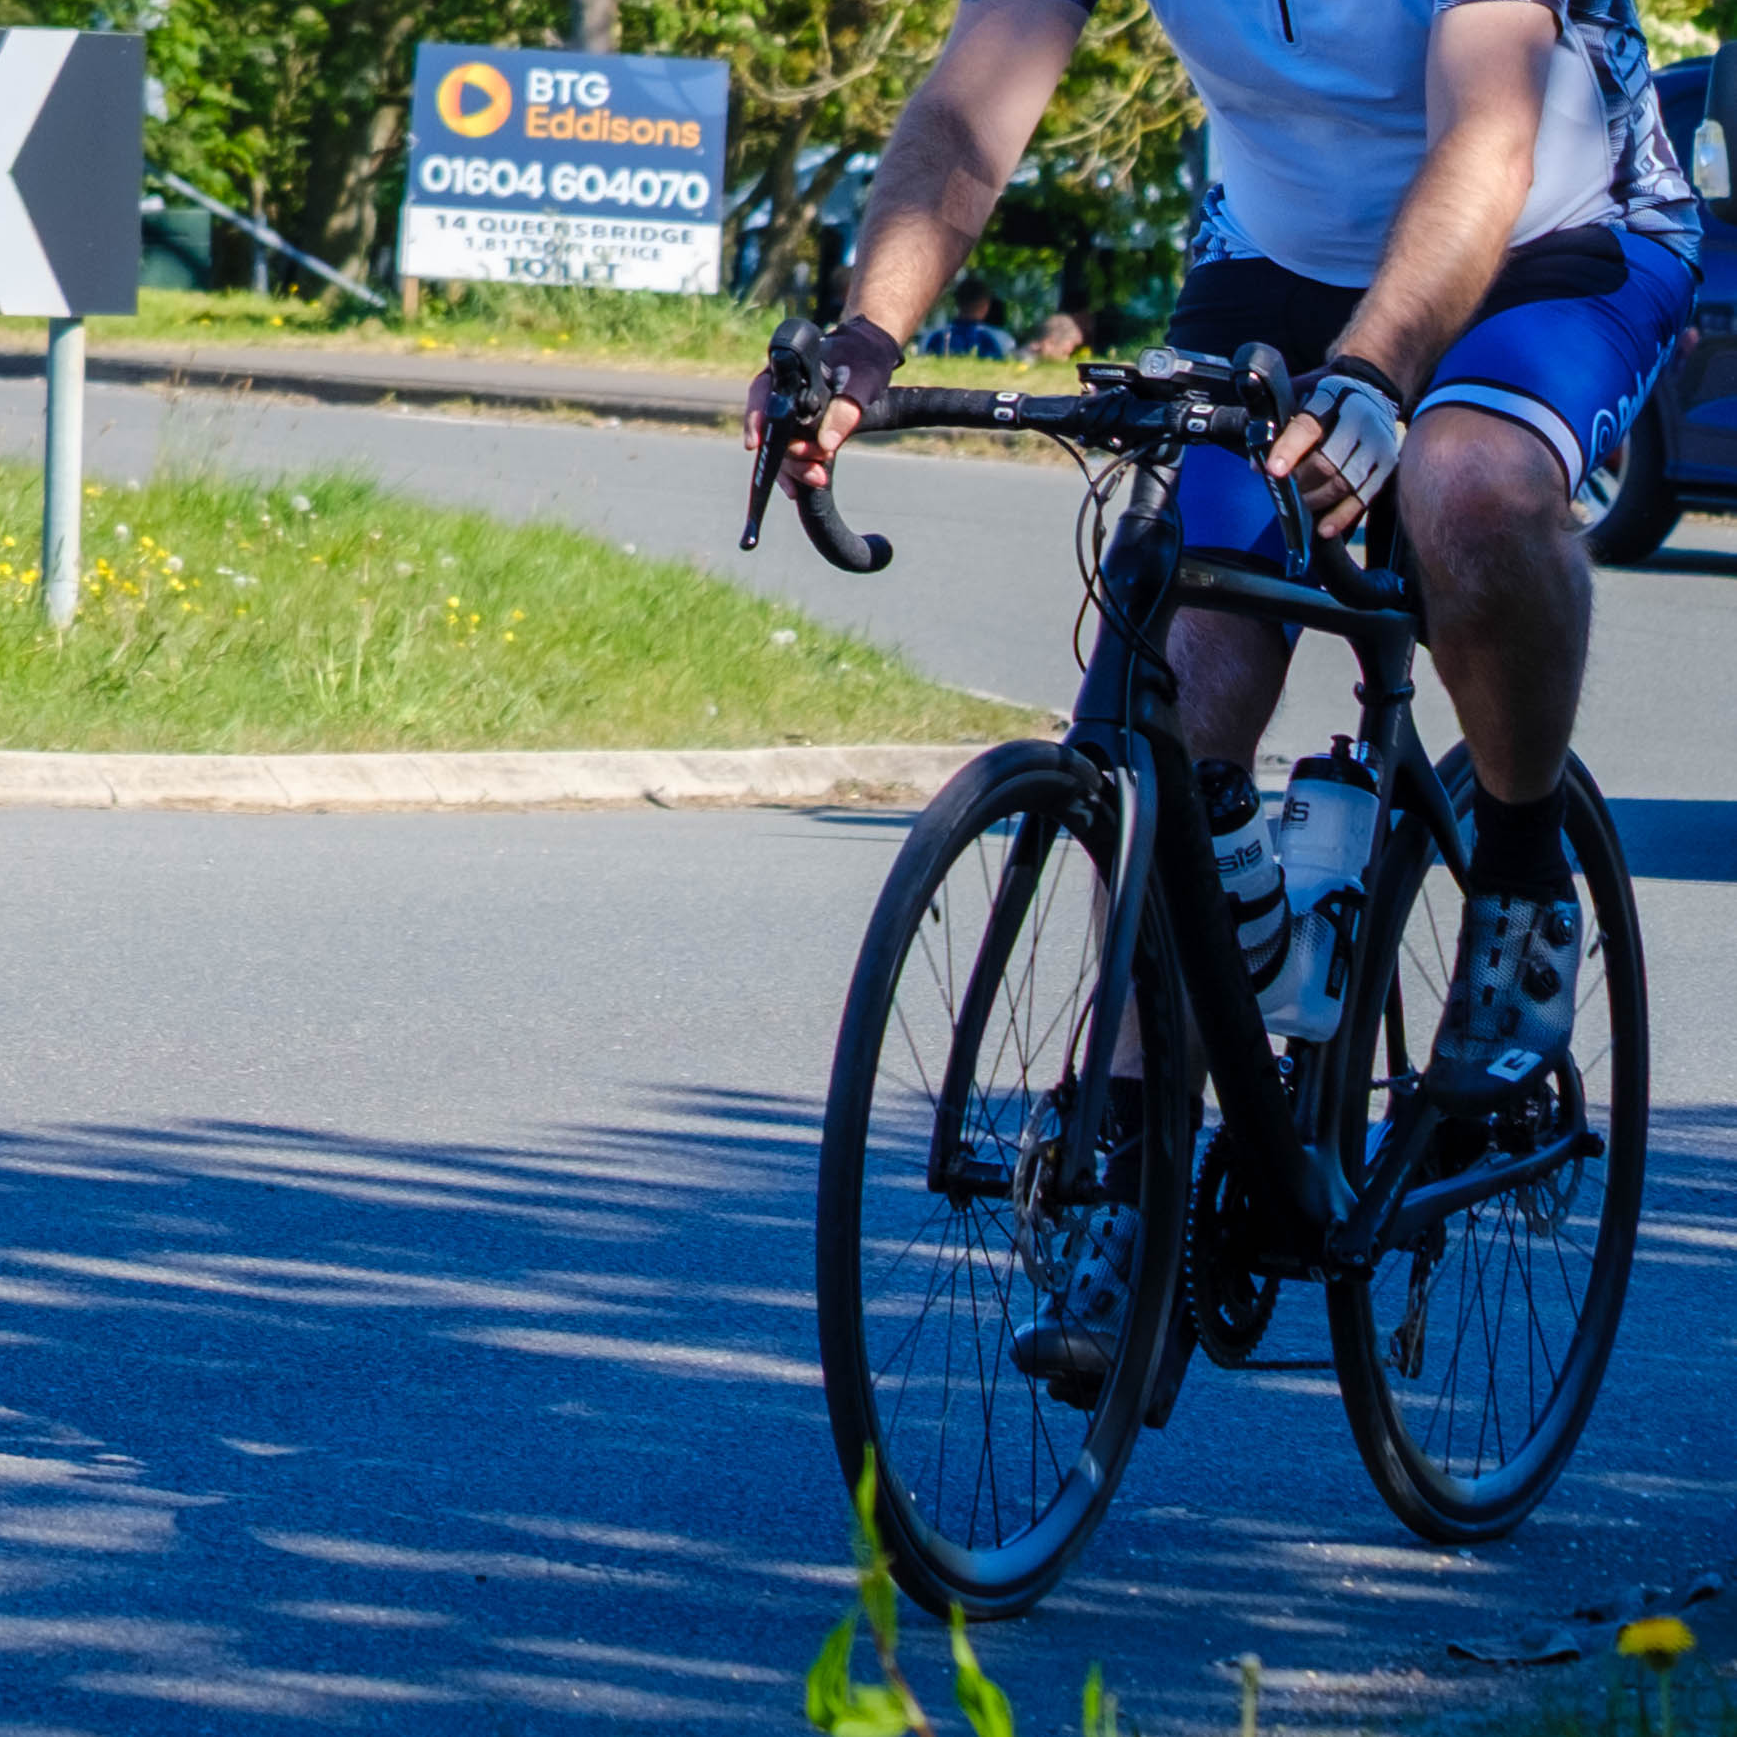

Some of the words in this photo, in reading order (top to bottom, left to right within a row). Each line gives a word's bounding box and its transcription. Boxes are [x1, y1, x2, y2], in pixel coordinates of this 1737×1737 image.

[527, 68, 610, 107] BTG
[525, 105, 702, 149] Eddisons
[419, 155, 545, 199] 01604
[548, 163, 710, 211] 604070
[435, 214, 468, 231] 14
[477, 217, 696, 246] QUEENSBRIDGE
